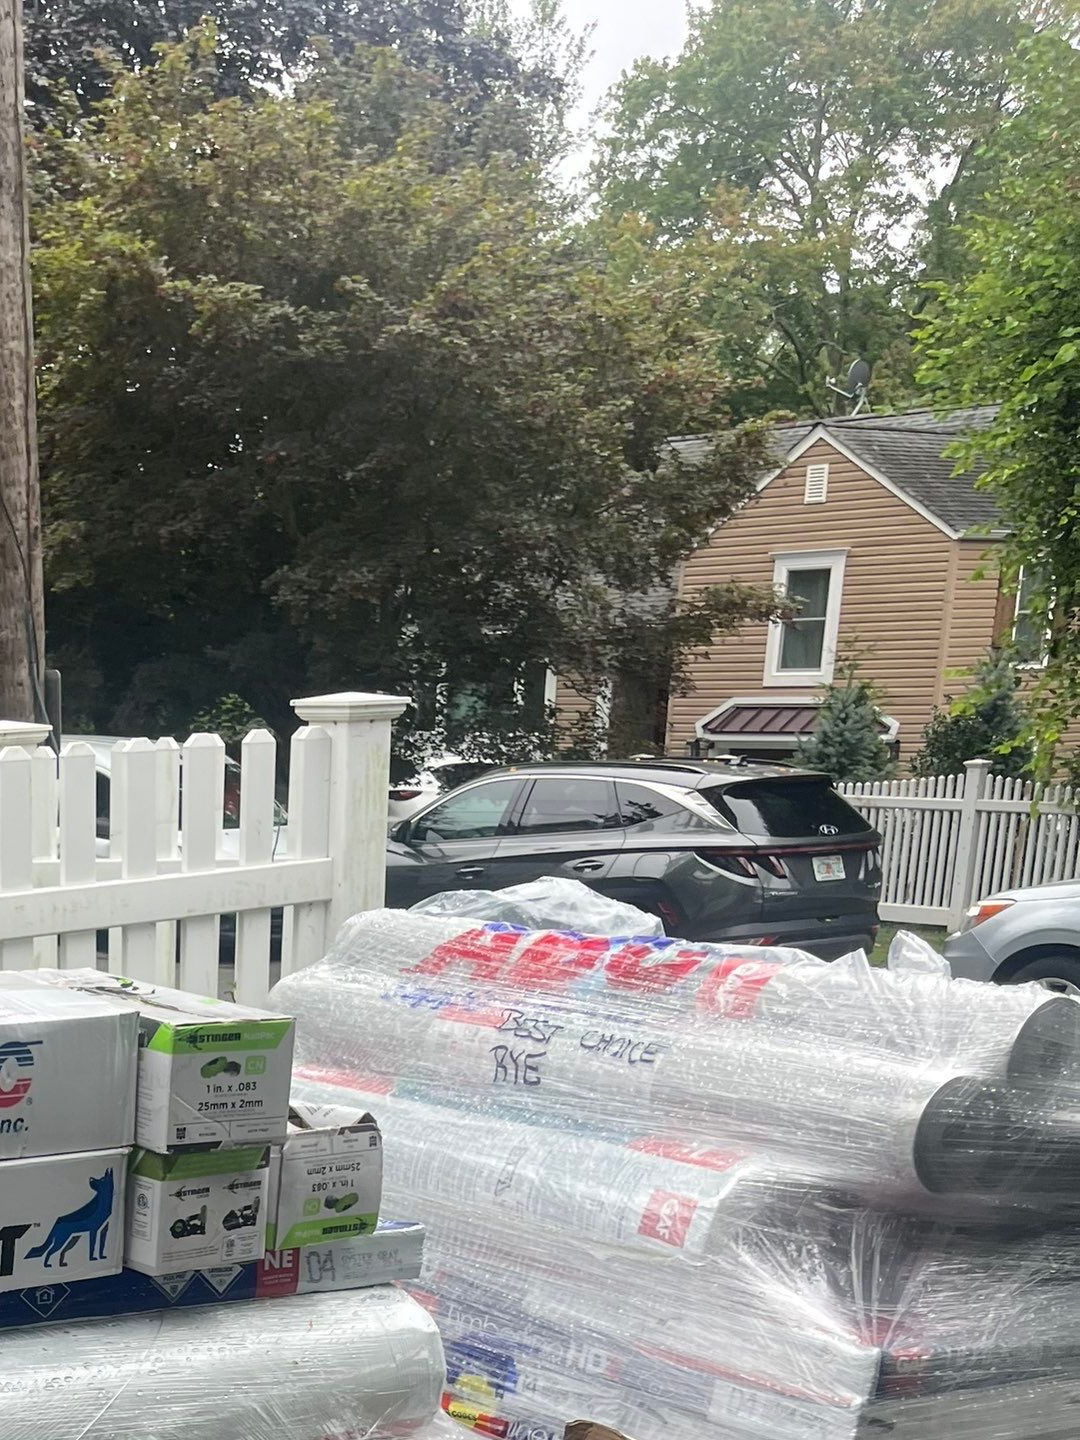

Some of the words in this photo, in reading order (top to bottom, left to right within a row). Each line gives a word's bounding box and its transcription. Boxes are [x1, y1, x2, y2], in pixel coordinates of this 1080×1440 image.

[496, 1008, 564, 1043] BEST
[580, 1029, 668, 1065] CHOICE
[489, 1044, 547, 1087] RYE
[235, 1081, 257, 1092] .083
[197, 1101, 228, 1112] 25mm
[238, 1099, 264, 1110] 2mm
[264, 1250, 293, 1271] NE
